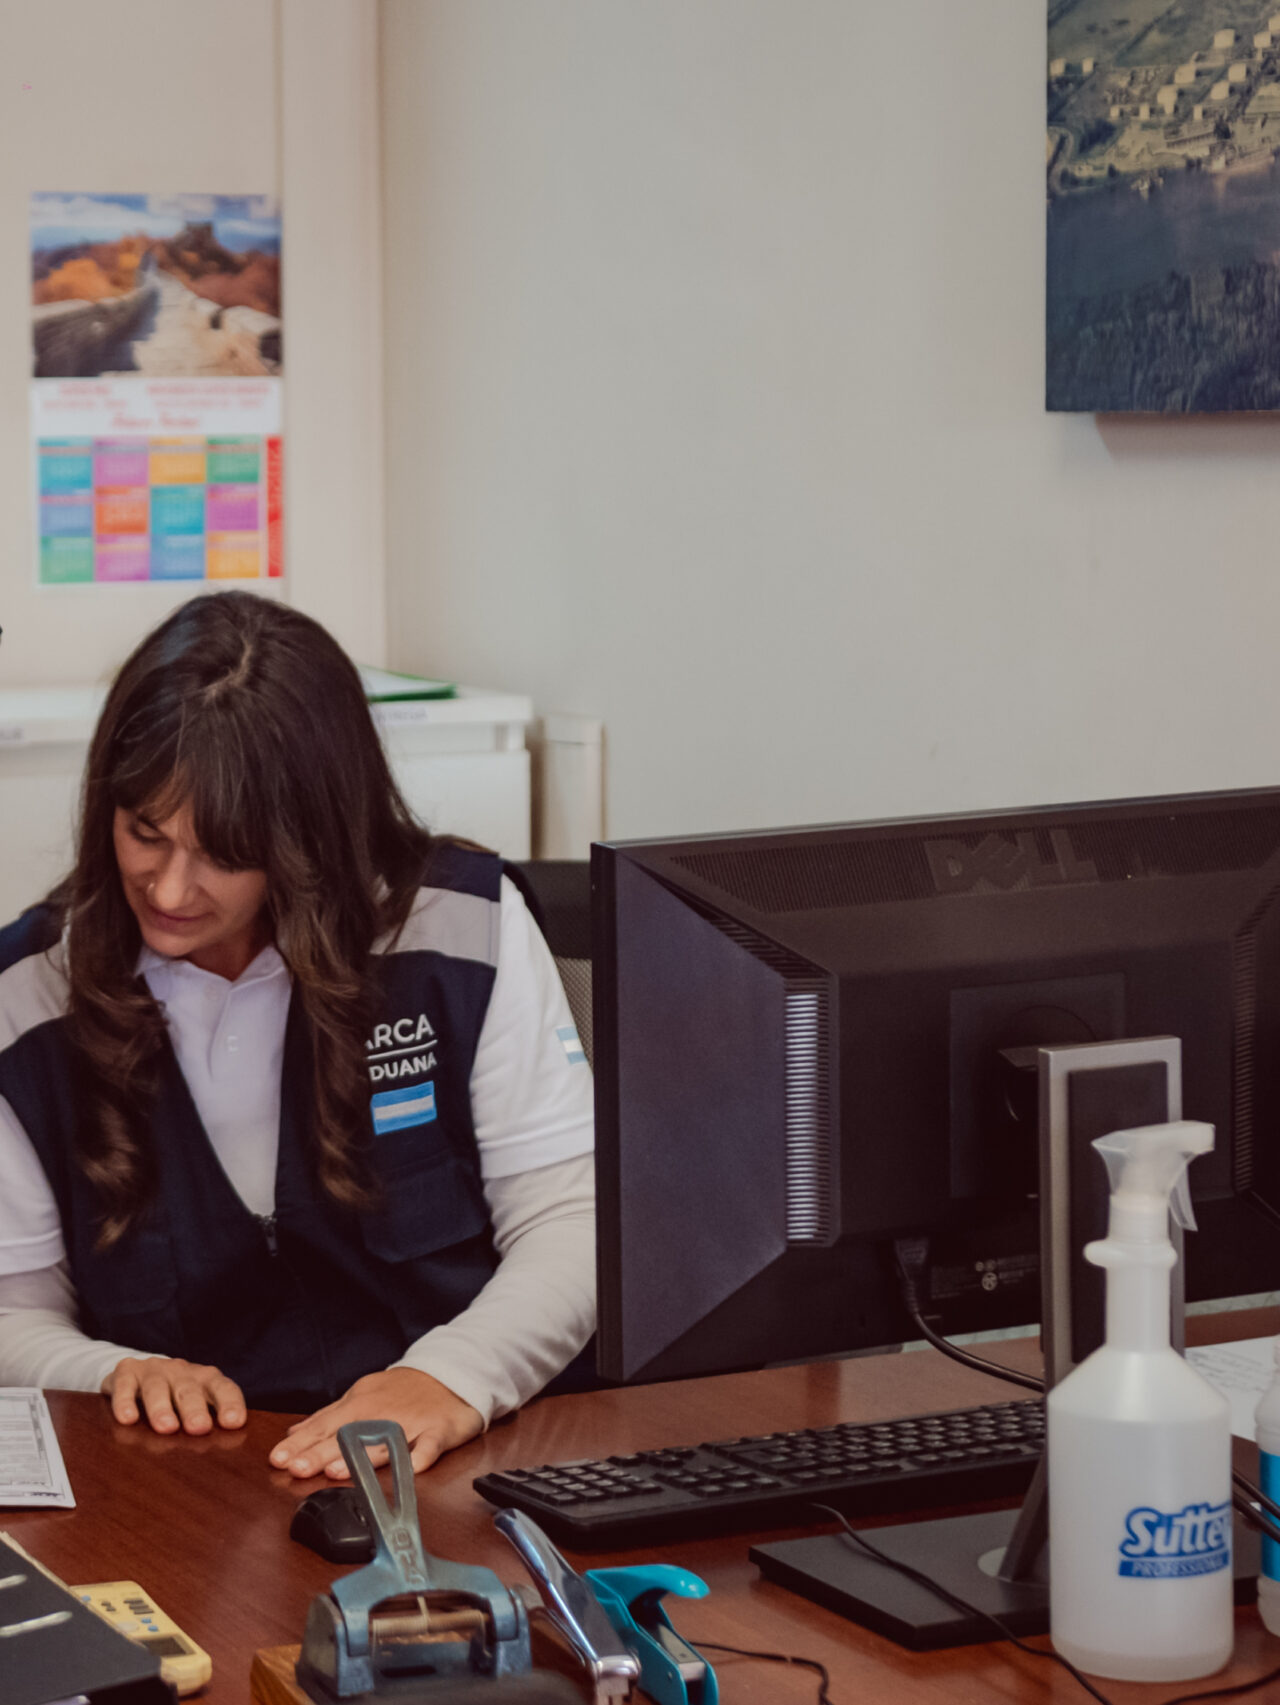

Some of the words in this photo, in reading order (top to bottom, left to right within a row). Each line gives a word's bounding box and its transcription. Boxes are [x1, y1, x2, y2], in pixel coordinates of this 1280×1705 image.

[925, 828, 1099, 894] DELL
[365, 1013, 435, 1050] RCA
[369, 1052, 437, 1082] DUANA
